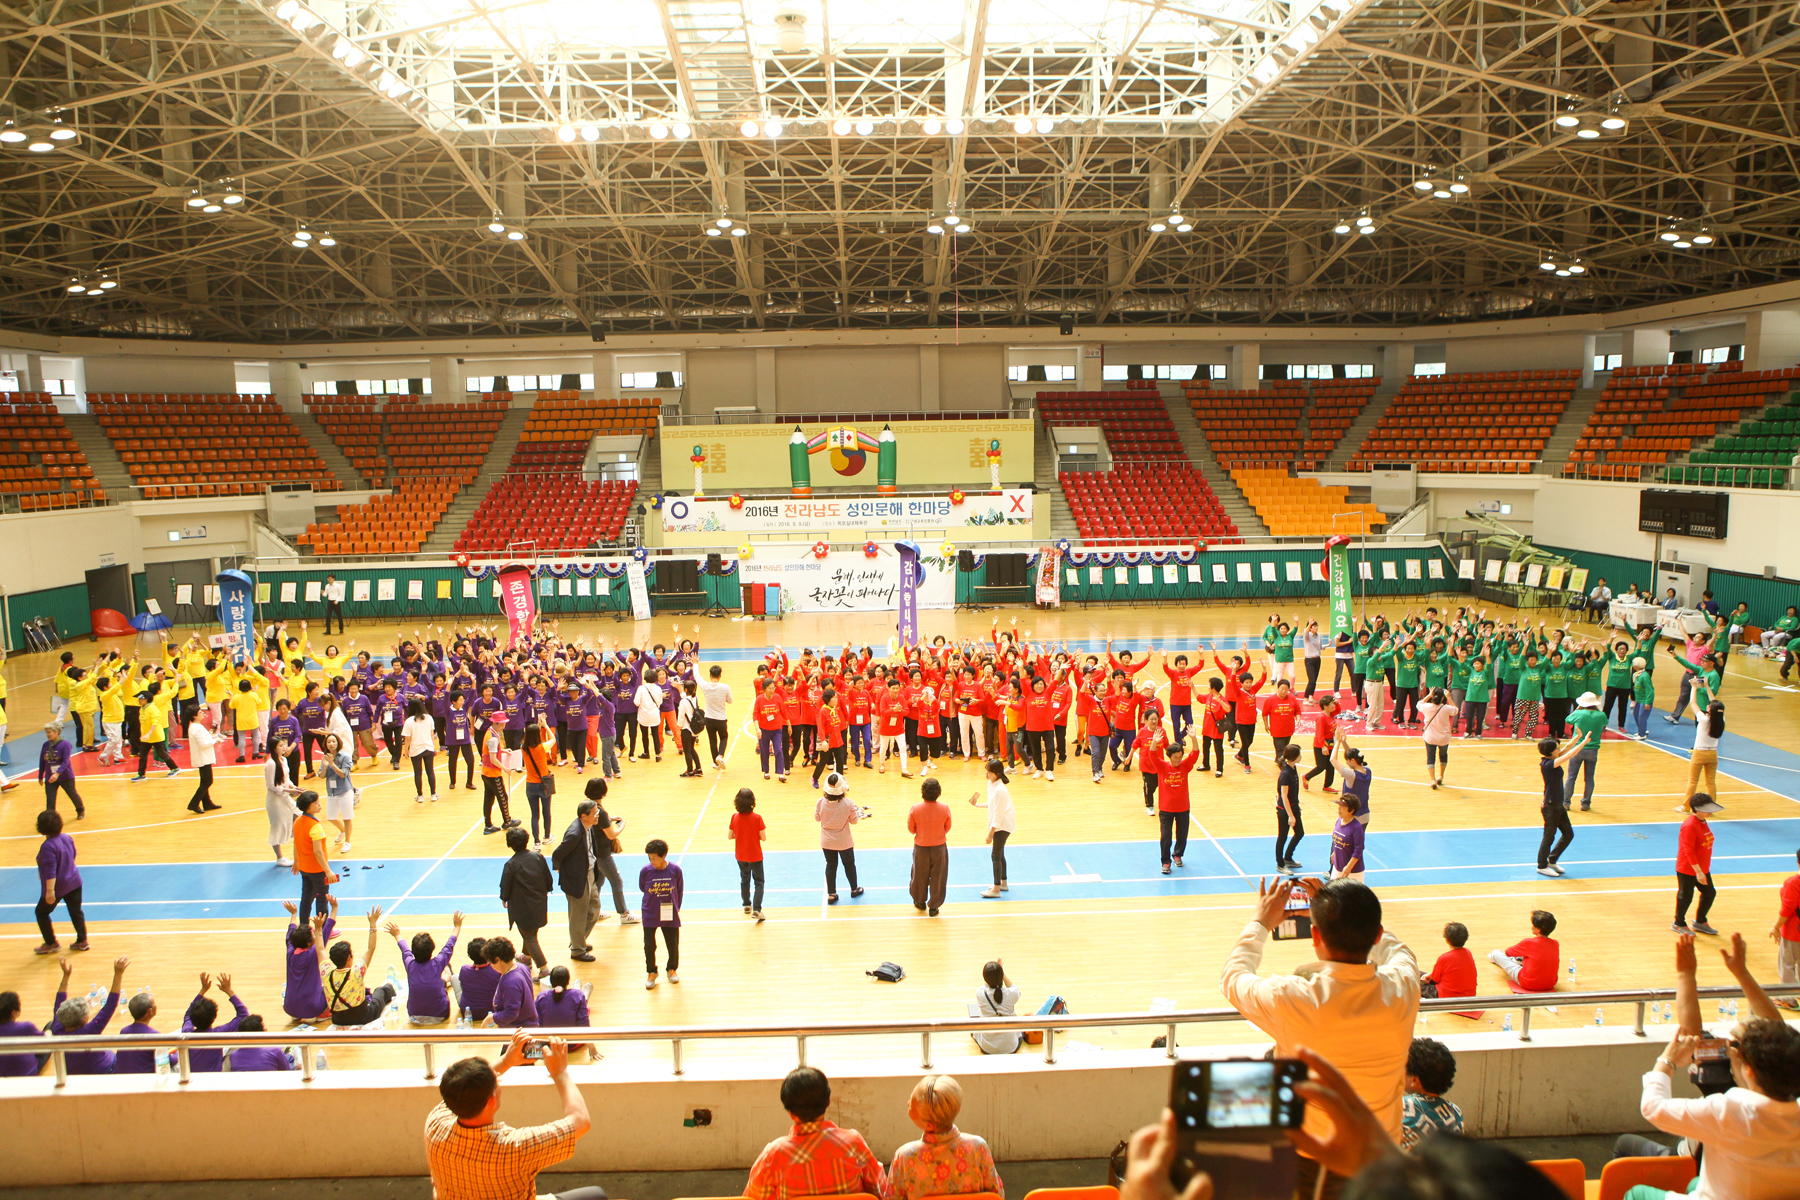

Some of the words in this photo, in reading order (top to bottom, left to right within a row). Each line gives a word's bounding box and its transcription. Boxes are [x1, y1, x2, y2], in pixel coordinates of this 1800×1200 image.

[745, 505, 779, 517] 2016년
[784, 503, 841, 518] 전라남도
[846, 501, 903, 517] 성인문해
[908, 501, 951, 516] 한마당
[809, 586, 855, 608] 글자꽃이
[855, 583, 900, 605] 피어나다
[1333, 554, 1348, 628] 건강하세요
